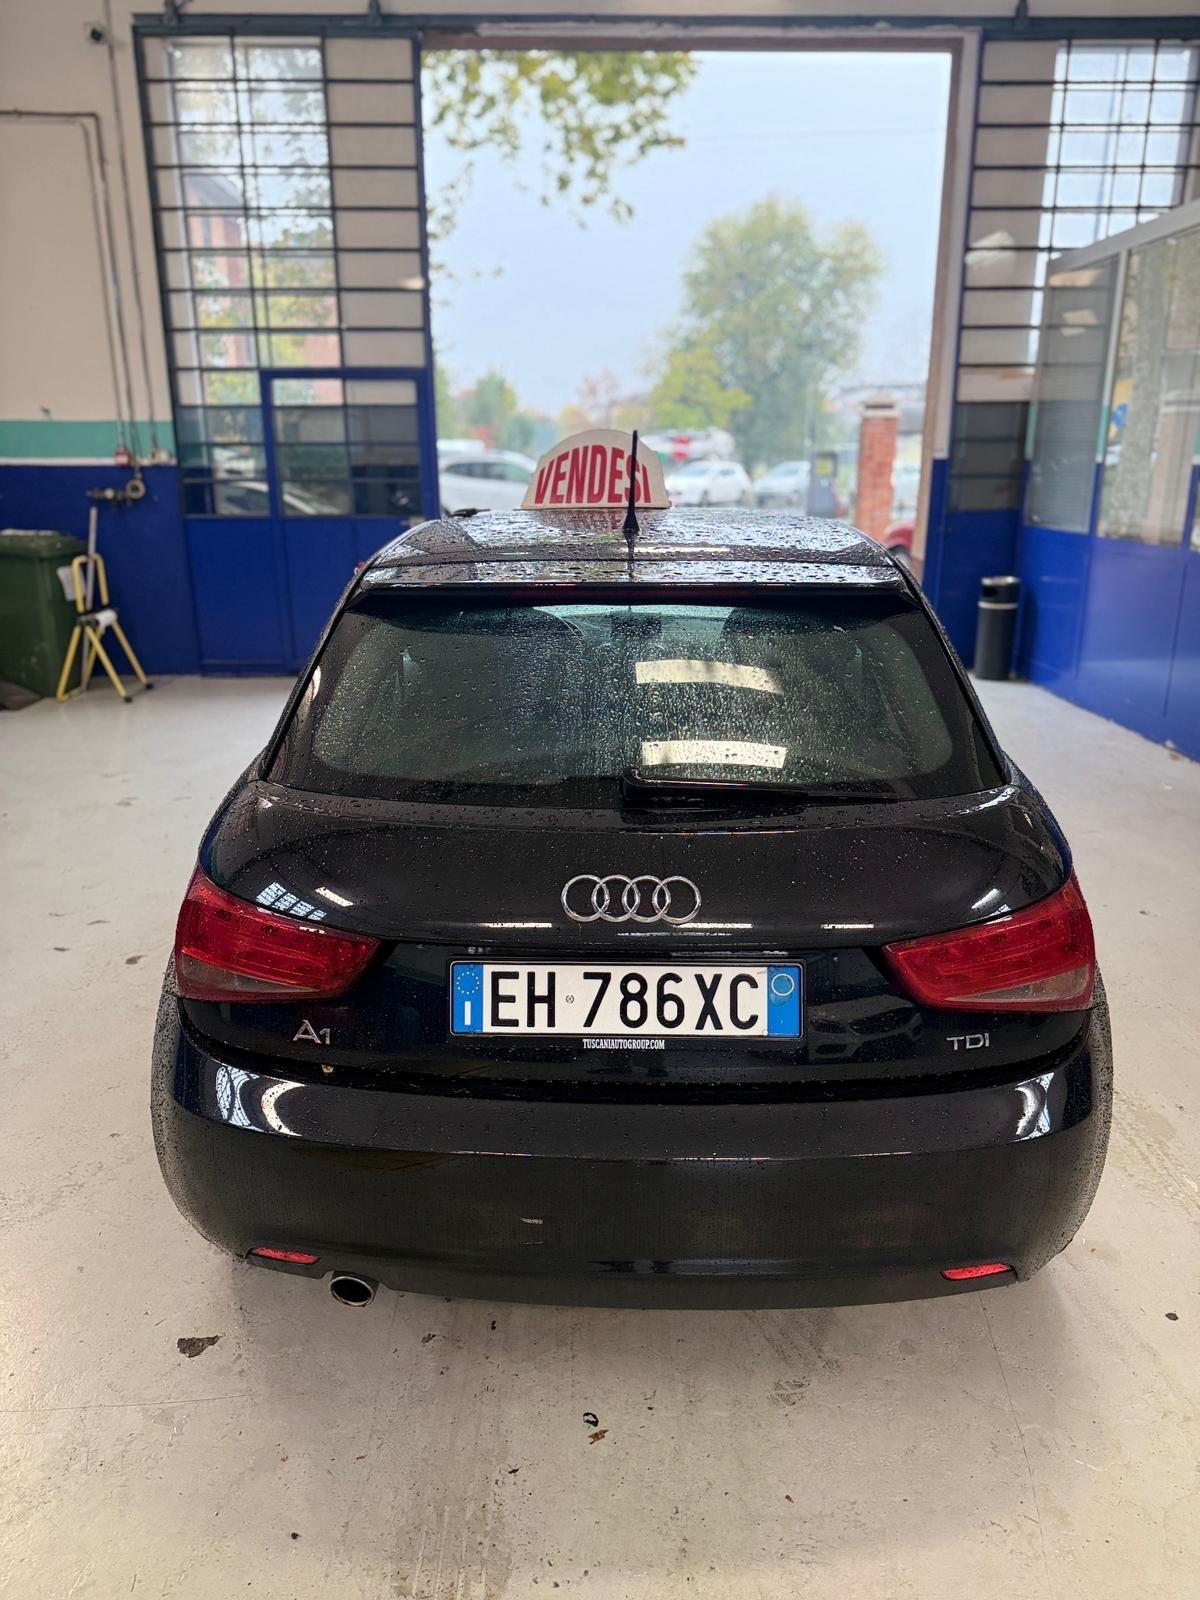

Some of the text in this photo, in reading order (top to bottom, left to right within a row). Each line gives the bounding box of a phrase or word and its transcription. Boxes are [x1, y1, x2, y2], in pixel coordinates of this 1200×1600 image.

[534, 445, 652, 504] VENDESI
[490, 971, 556, 1028] EH
[582, 971, 759, 1030] 786XC
[292, 1019, 331, 1045] A1
[582, 1038, 665, 1050] TUSCANIAUTOGROUP.COM
[946, 1032, 990, 1051] TDI
